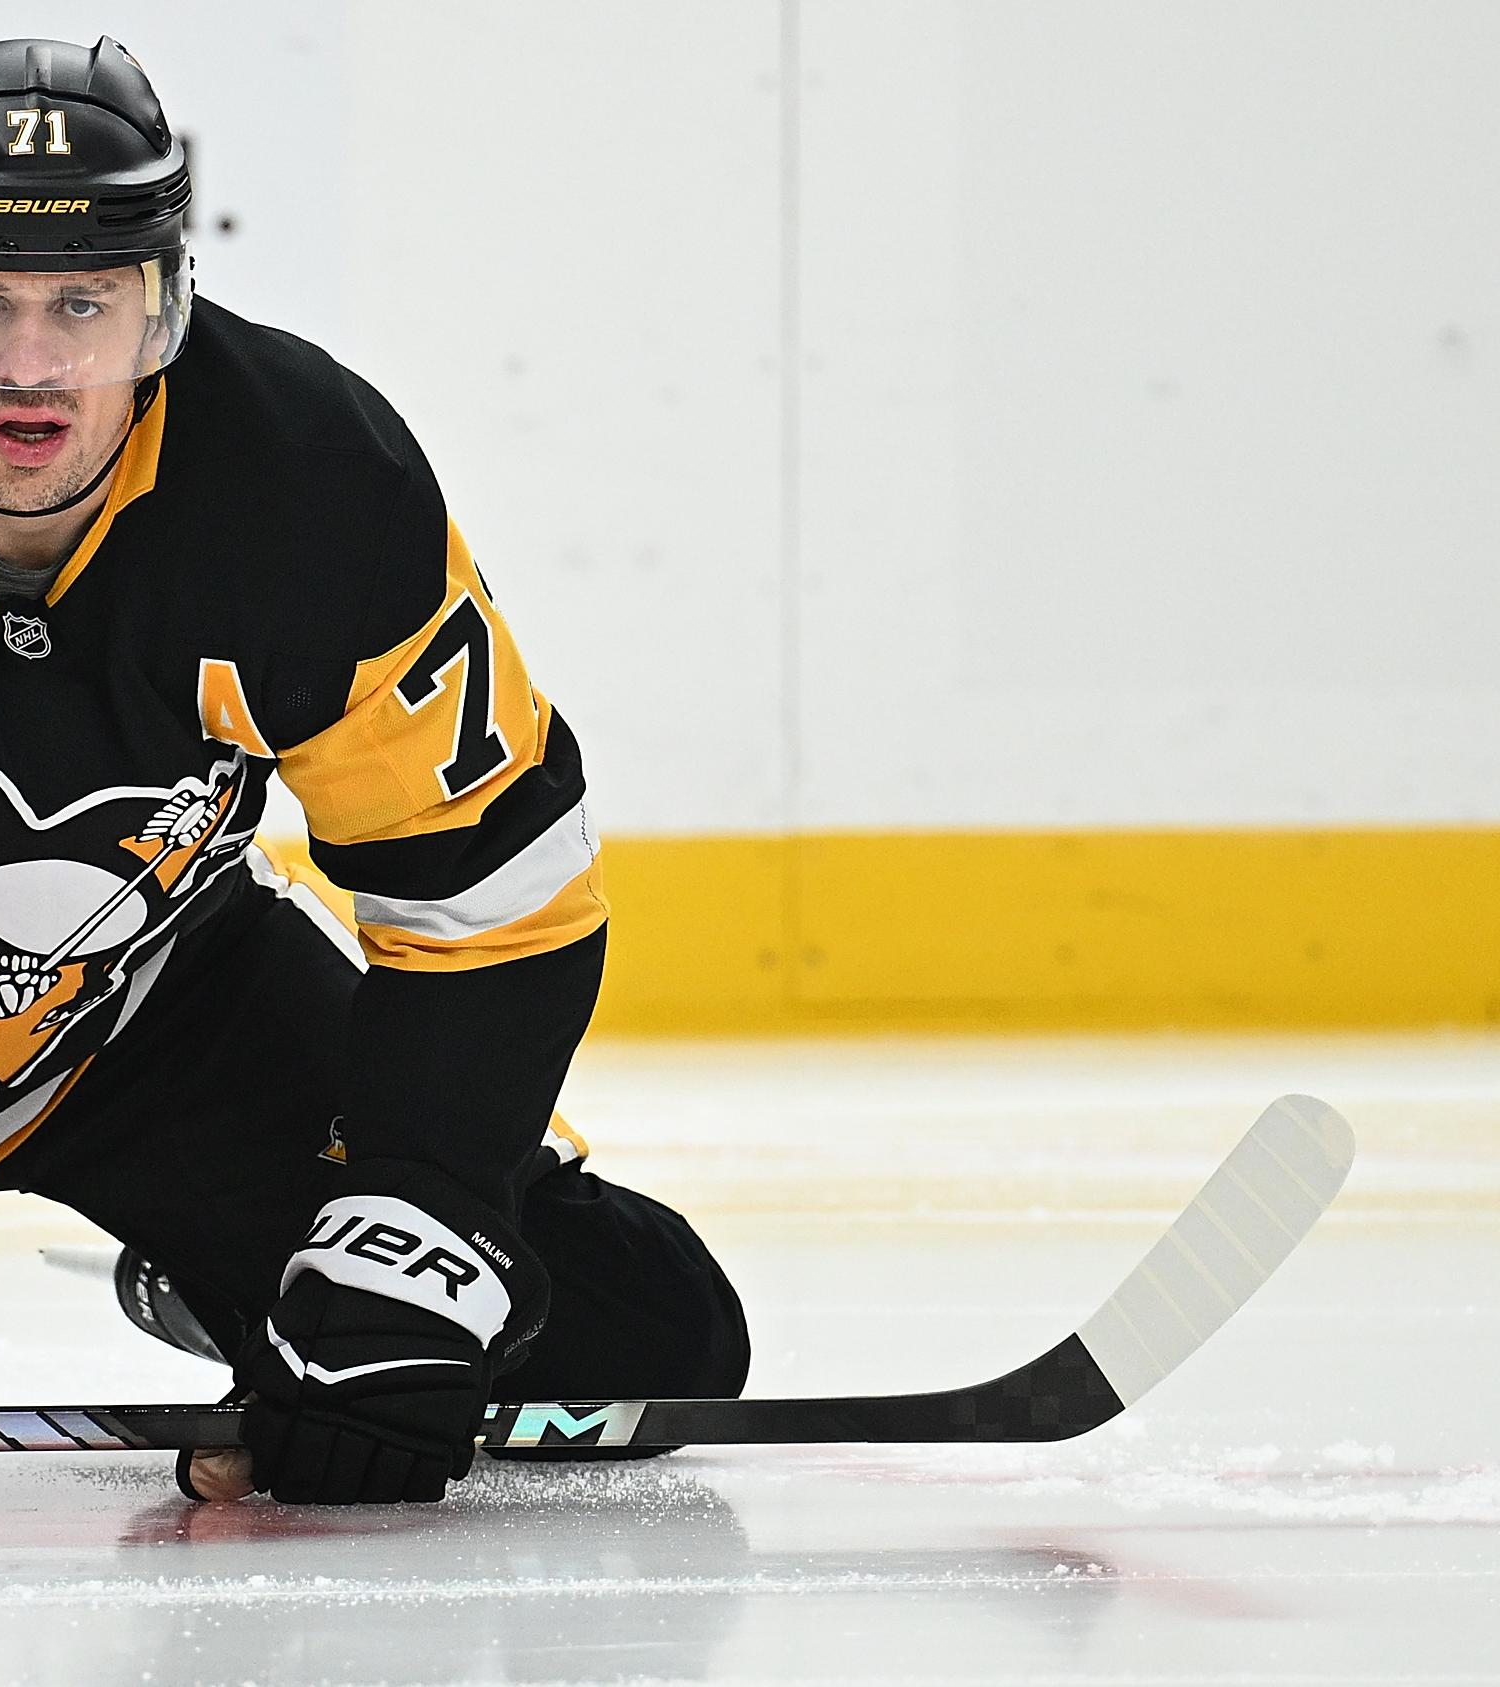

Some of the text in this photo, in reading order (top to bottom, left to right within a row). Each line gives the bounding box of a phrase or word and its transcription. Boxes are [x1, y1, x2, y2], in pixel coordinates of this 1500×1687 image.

[6, 108, 71, 156] 71
[14, 628, 40, 648] NHL
[197, 657, 277, 759] A
[393, 560, 539, 803] 7
[303, 1214, 481, 1302] UER
[470, 1231, 514, 1270] MALKIN
